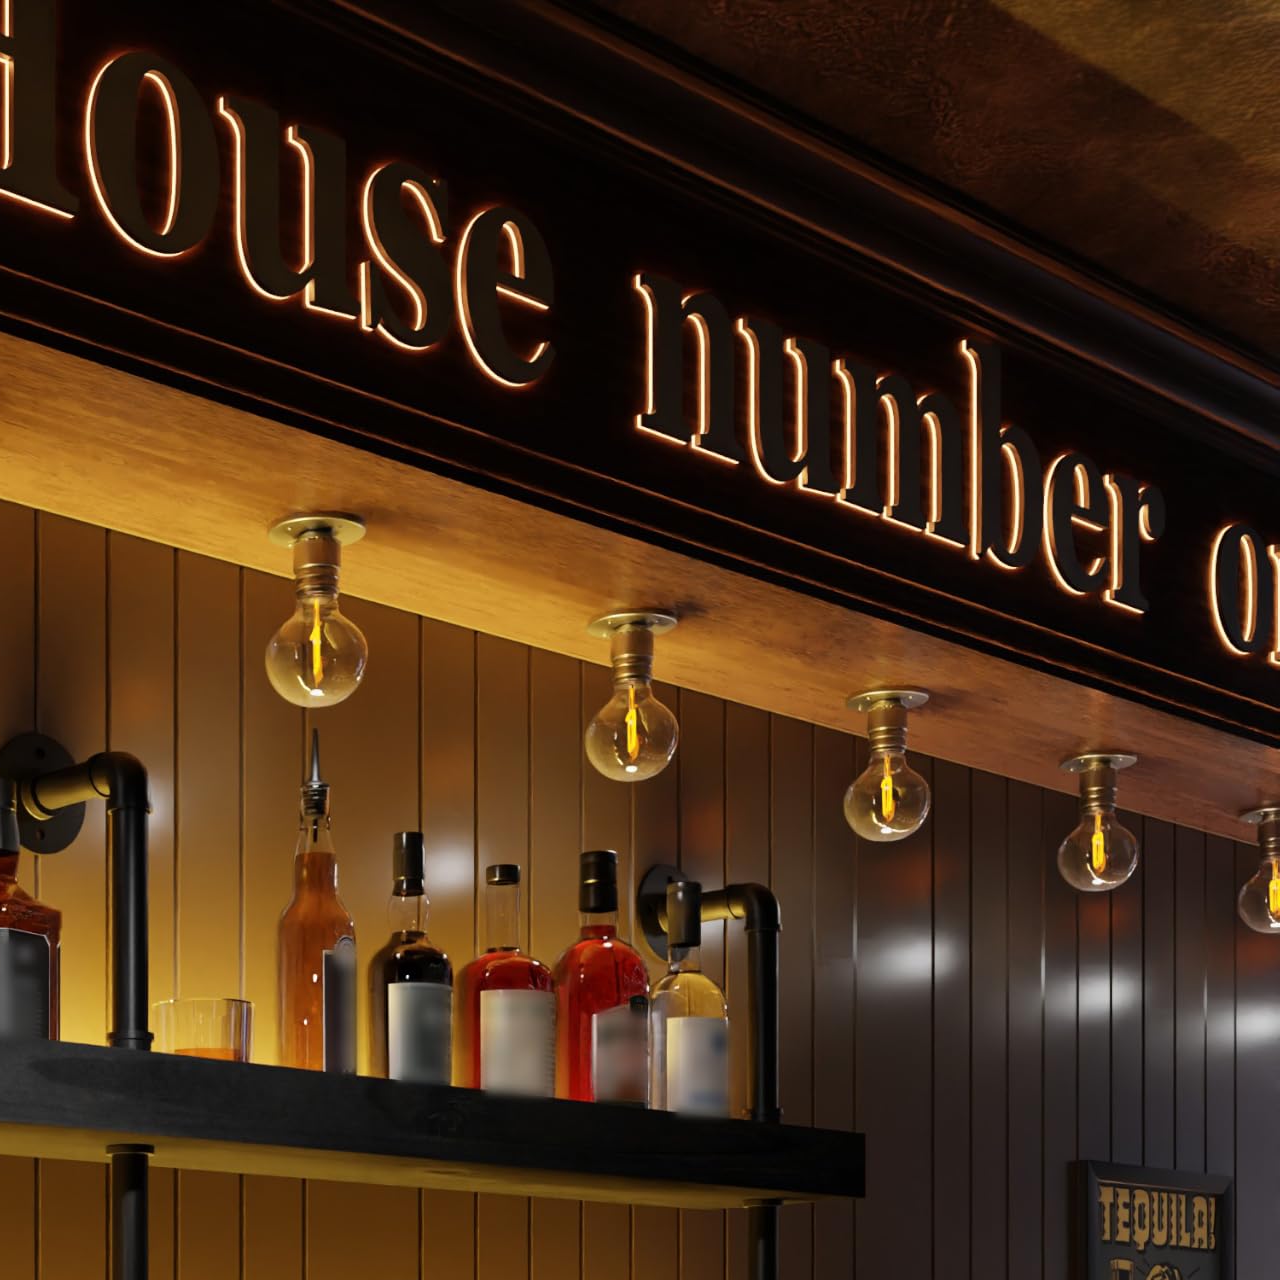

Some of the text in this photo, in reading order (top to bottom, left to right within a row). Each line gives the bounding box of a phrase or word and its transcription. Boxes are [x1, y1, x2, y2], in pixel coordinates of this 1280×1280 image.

[634, 273, 1165, 614] number
[1208, 523, 1280, 666] o
[1098, 1184, 1217, 1251] TEQUILA!
